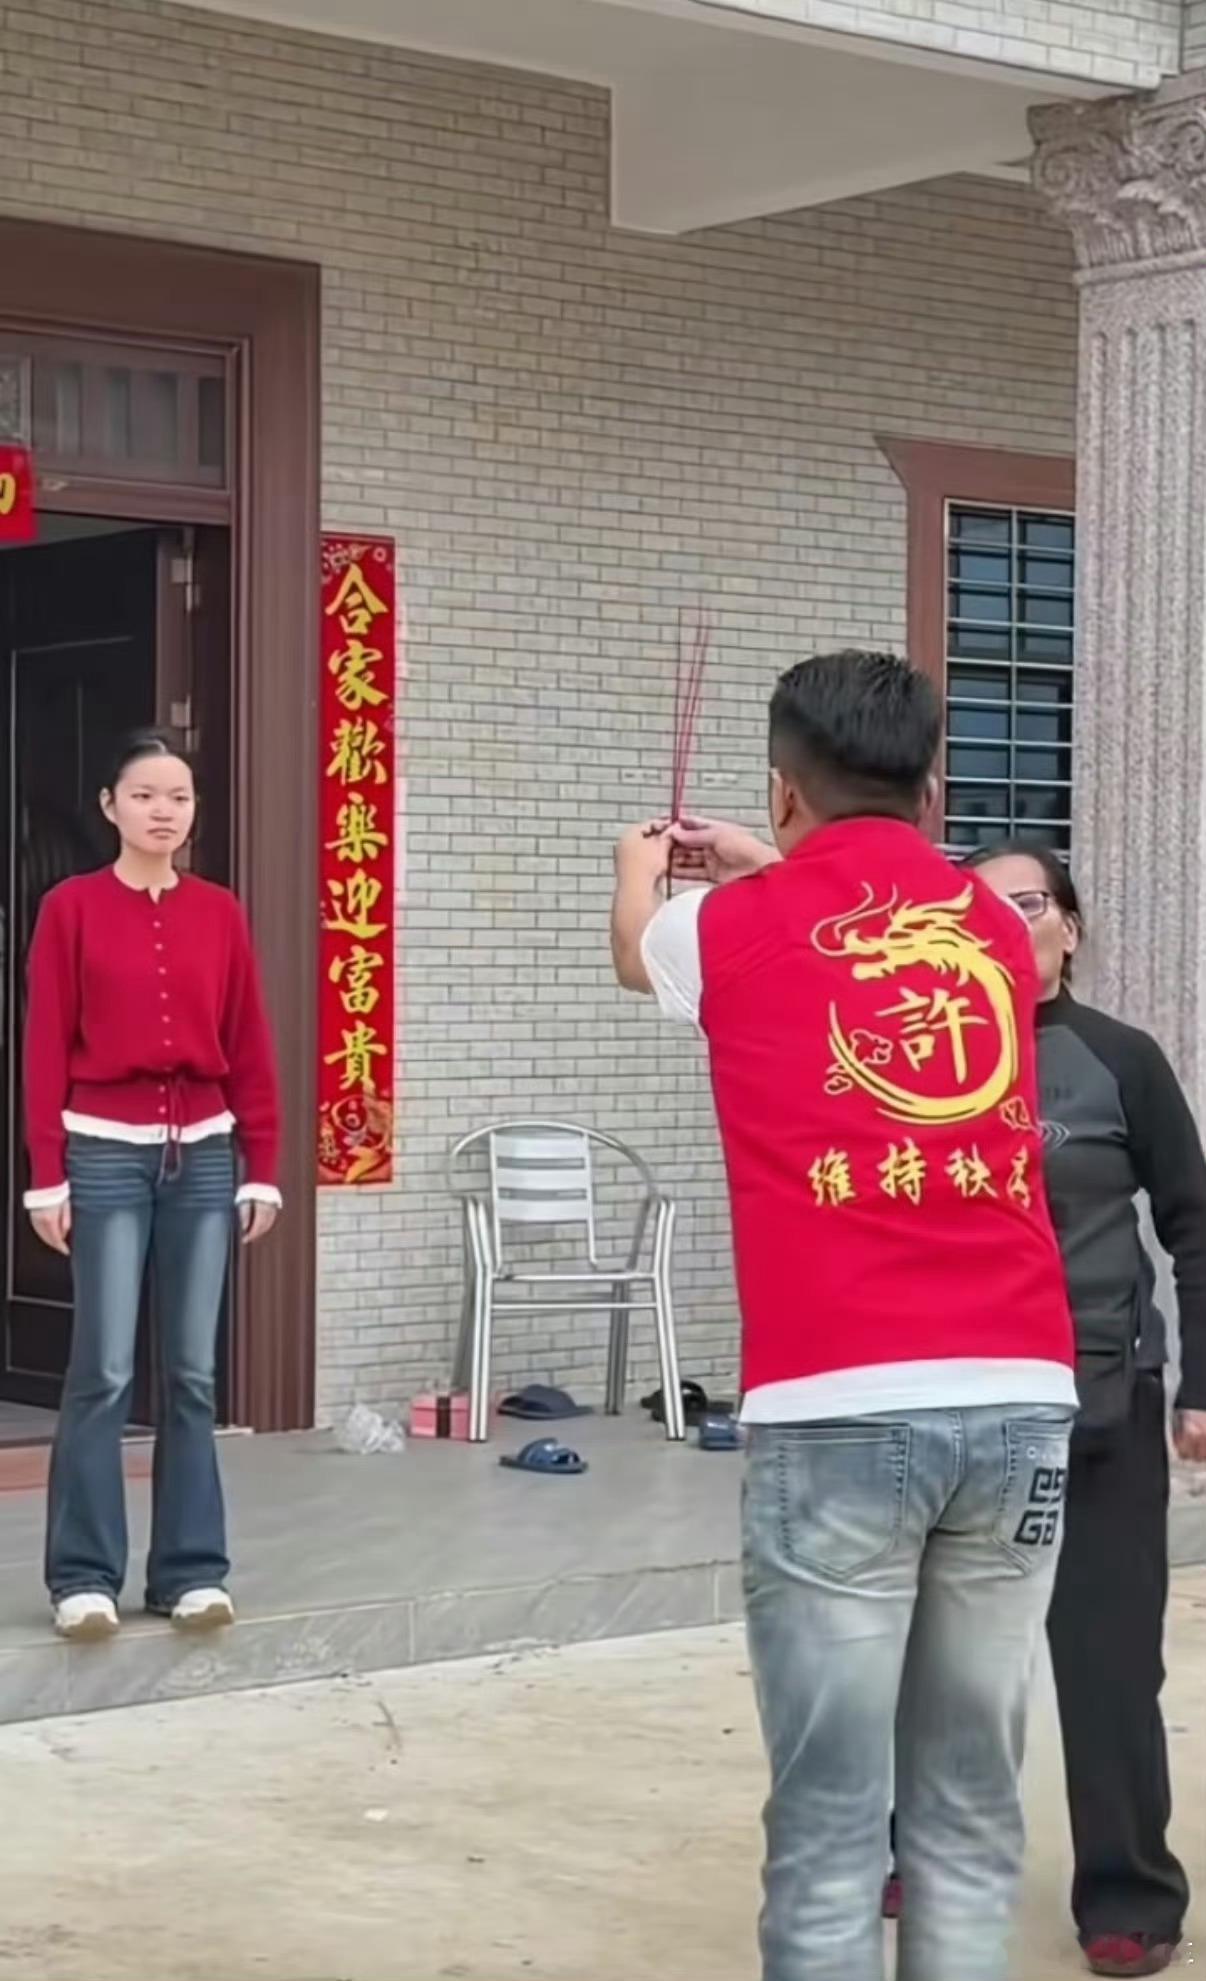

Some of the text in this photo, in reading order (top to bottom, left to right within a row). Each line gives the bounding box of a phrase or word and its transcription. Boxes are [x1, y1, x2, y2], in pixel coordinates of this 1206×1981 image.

[325, 563, 389, 1092] 合家歡樂迎富貴
[876, 986, 990, 1085] 許
